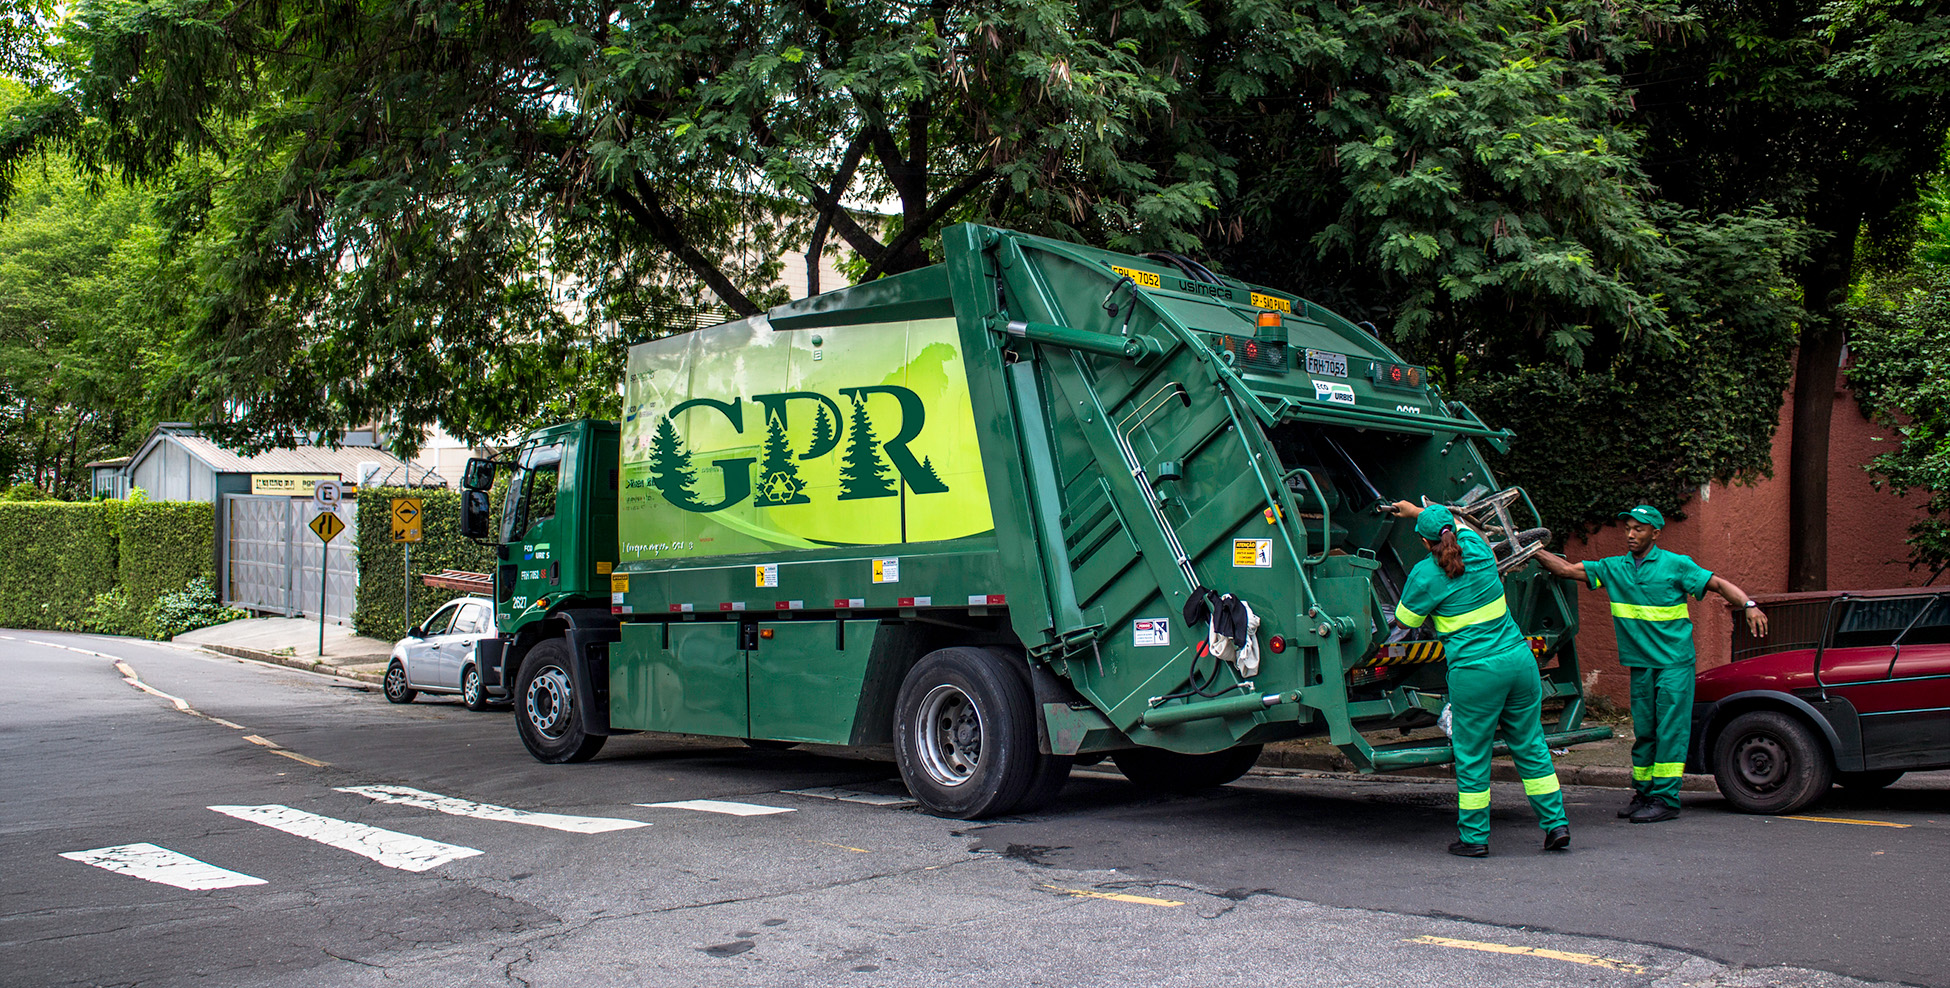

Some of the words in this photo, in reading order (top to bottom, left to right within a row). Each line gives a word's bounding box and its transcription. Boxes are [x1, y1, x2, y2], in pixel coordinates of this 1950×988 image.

[1138, 271, 1159, 287] 7052
[1179, 279, 1233, 300] usimeca
[1308, 357, 1346, 375] FRH-7052
[1316, 383, 1329, 391] ECO
[1334, 392, 1353, 402] URBIS
[649, 384, 949, 513] GPR
[323, 486, 333, 500] E
[512, 595, 527, 609] 2627
